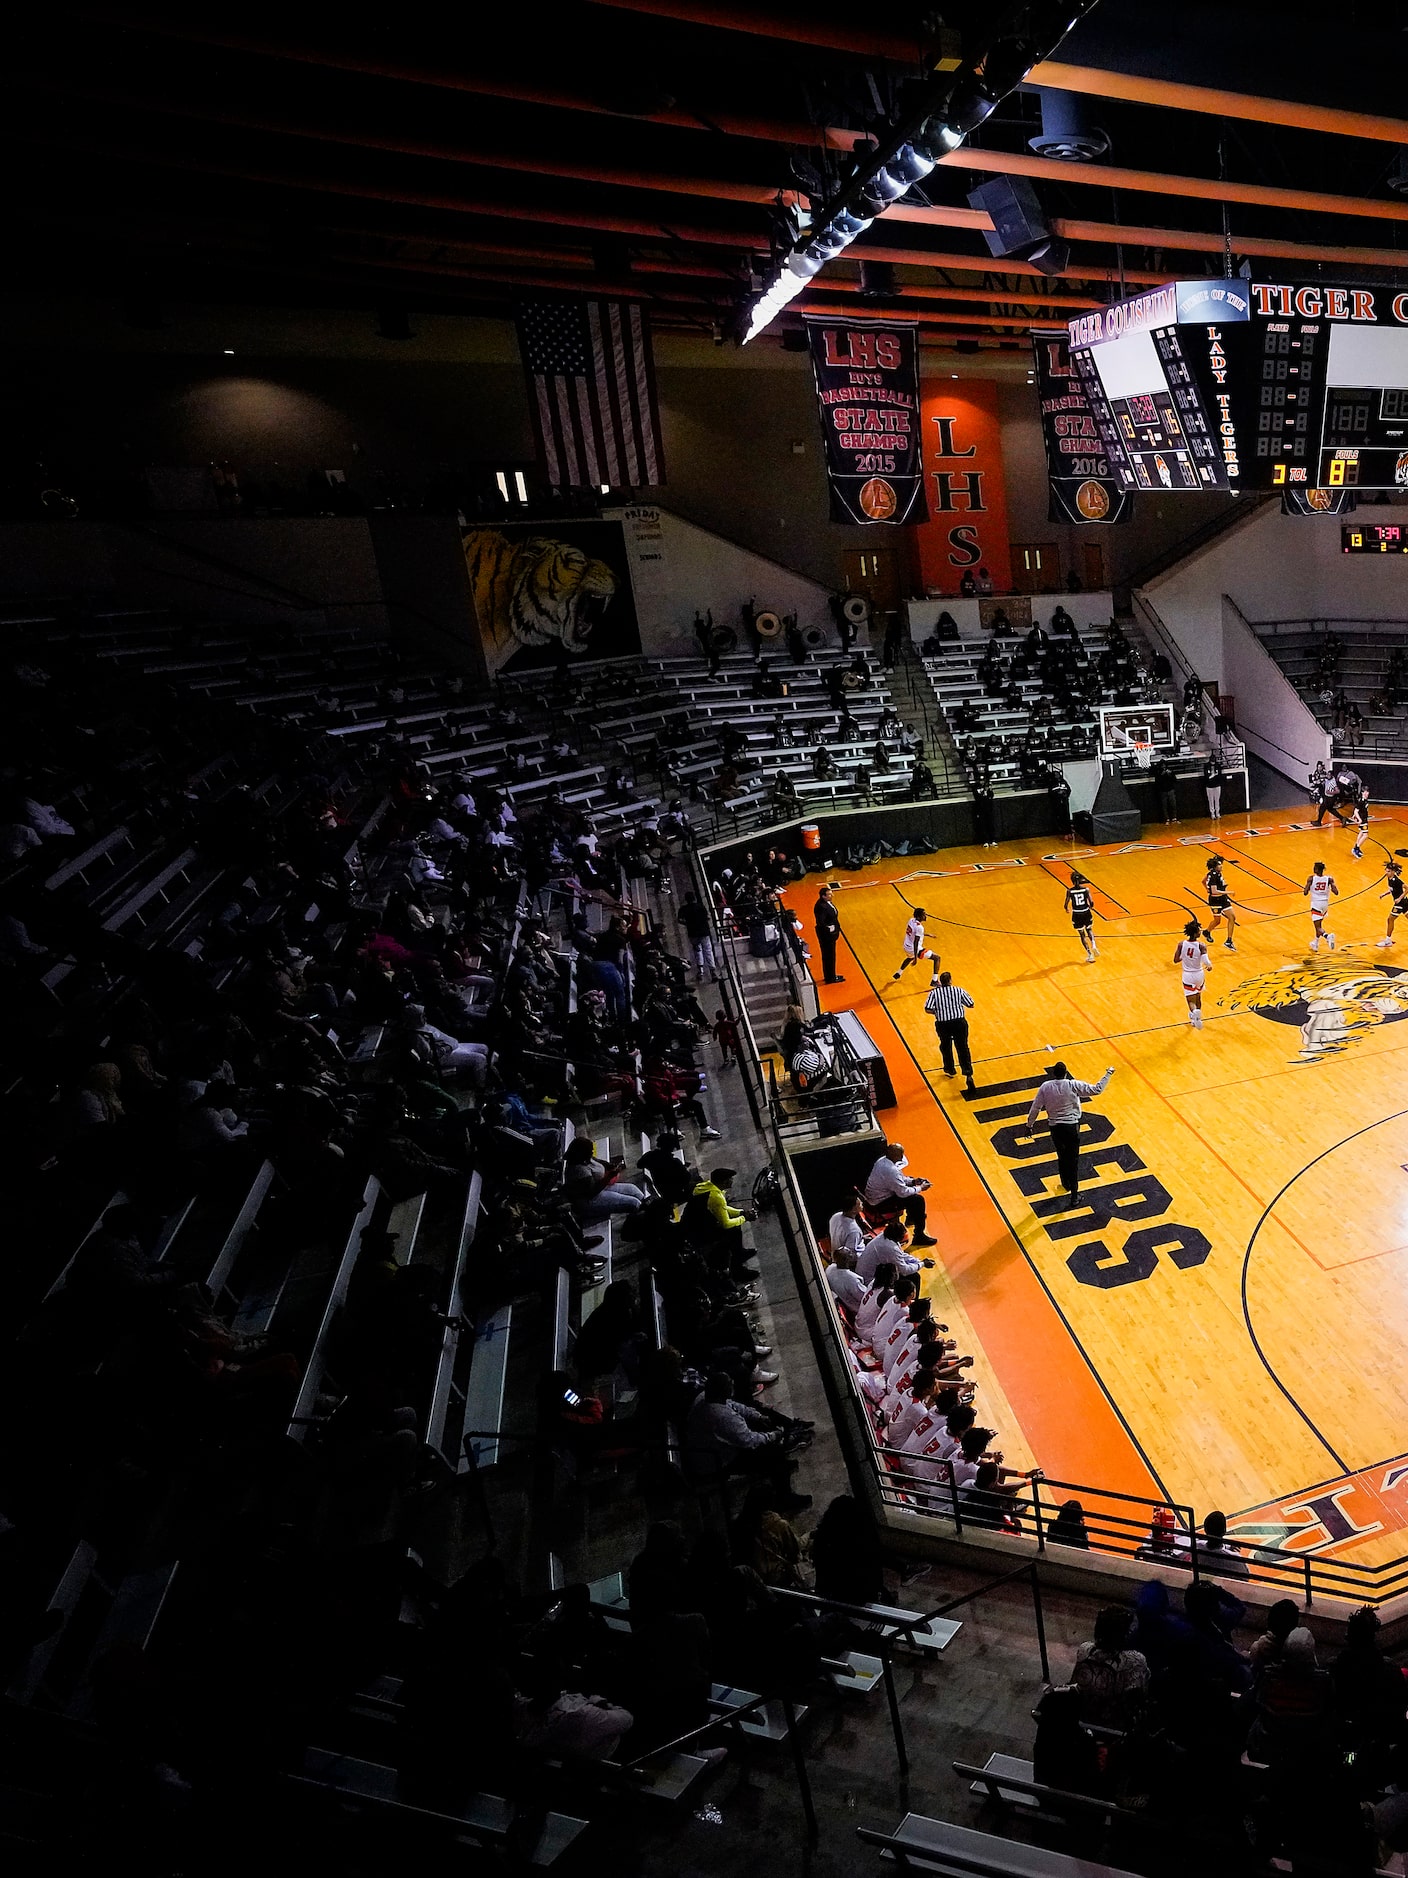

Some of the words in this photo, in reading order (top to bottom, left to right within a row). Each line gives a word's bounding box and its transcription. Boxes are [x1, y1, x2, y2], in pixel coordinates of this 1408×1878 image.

[1211, 288, 1226, 301] OF
[1251, 283, 1378, 321] TIGER
[1069, 311, 1103, 348] TIGER
[1105, 287, 1176, 338] COLISEUM
[822, 329, 902, 370] LHS
[1206, 326, 1226, 384] LADY
[848, 371, 884, 386] BOYS
[819, 386, 915, 410] BASKETBALL
[832, 407, 911, 432] STATE
[839, 432, 909, 451] CHAMPS
[1215, 394, 1241, 478] TIGERS
[854, 453, 897, 473] 2015
[1335, 450, 1360, 460] FOULS
[1071, 458, 1108, 476] 2016
[1289, 467, 1308, 481] TOL
[1351, 533, 1363, 547] 13
[1374, 527, 1400, 540] 7:39
[1380, 542, 1387, 552] 2
[1314, 881, 1327, 891] 33
[1073, 893, 1086, 906] 12
[1187, 947, 1195, 959] 4
[960, 1064, 1213, 1290] TIGERS
[887, 1328, 902, 1345] 3
